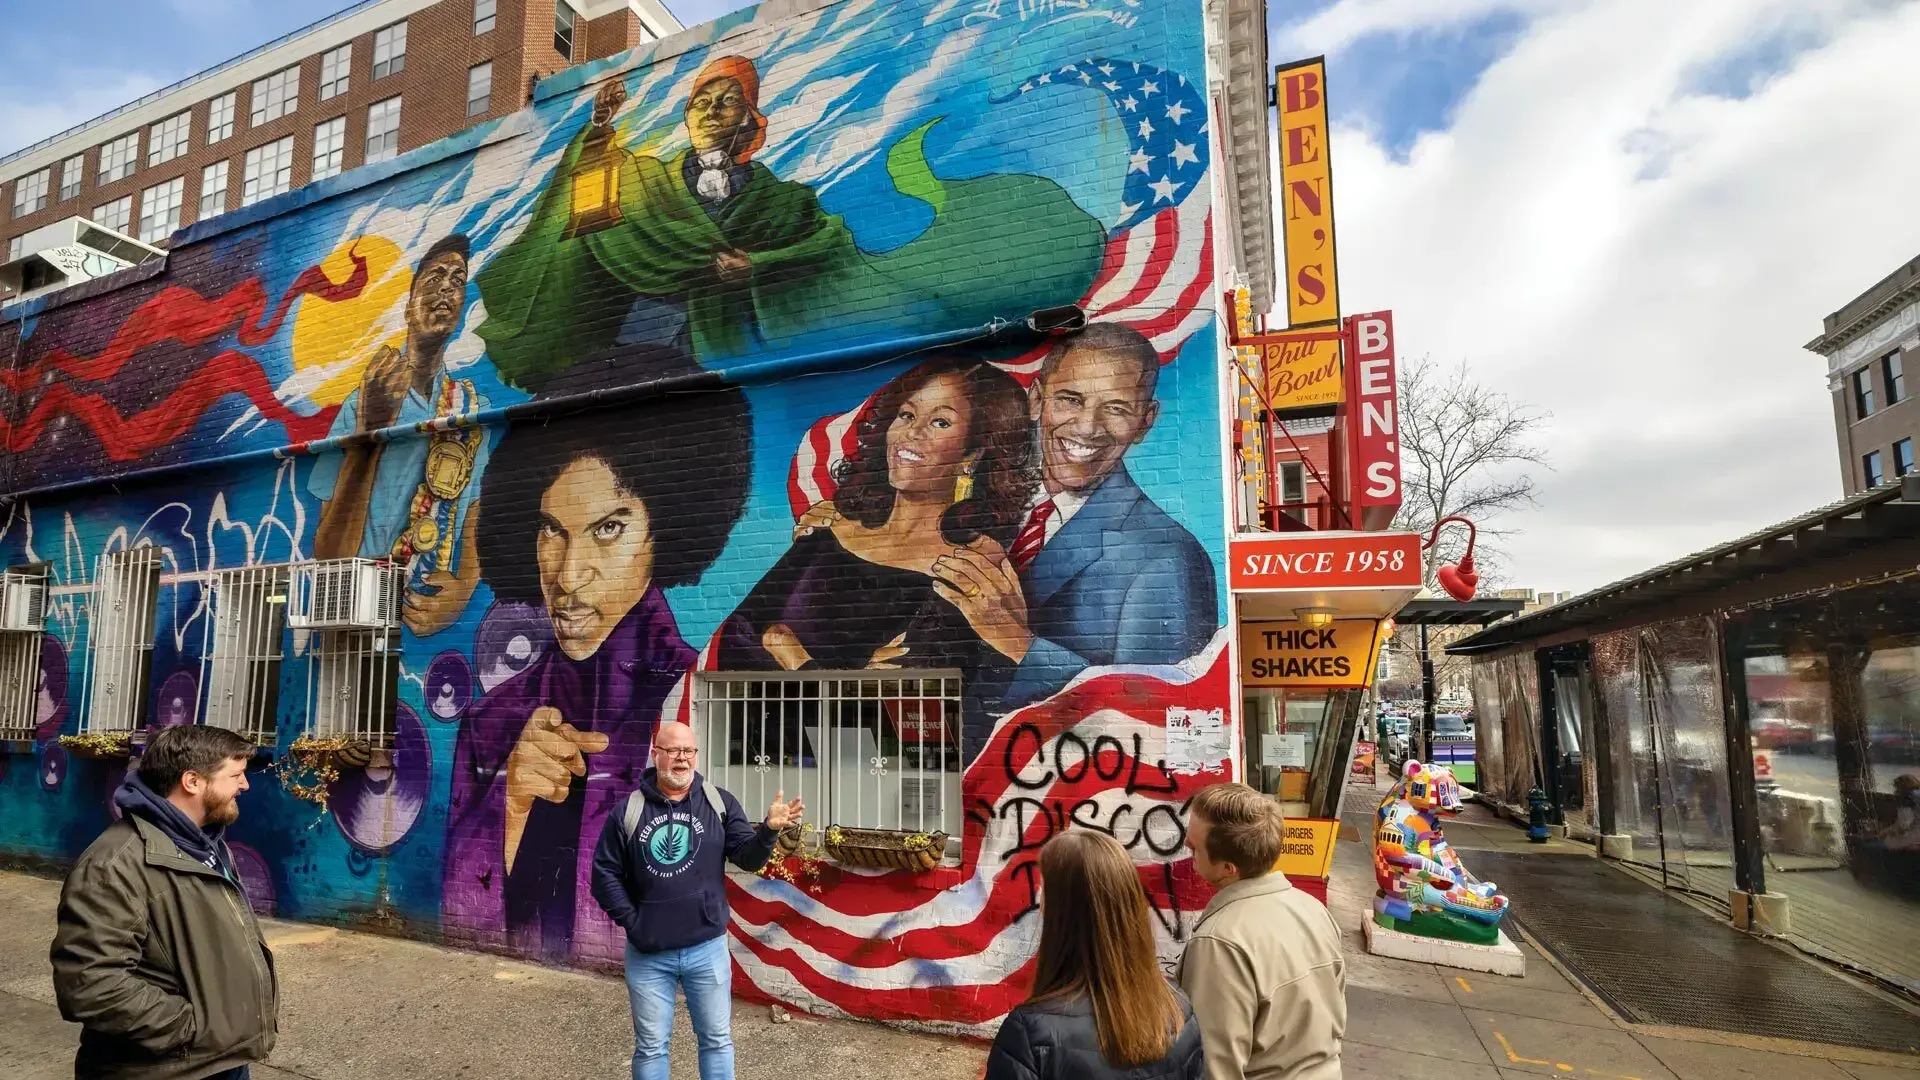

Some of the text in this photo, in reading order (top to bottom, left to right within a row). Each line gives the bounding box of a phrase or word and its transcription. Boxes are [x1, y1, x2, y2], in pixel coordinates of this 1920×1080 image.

[1281, 71, 1326, 307] BEN'S
[1265, 352, 1338, 400] Bowl
[1357, 319, 1396, 498] BEN'S
[1242, 549, 1405, 576] SINCE 1958
[1262, 628, 1337, 650] THICK
[1251, 656, 1351, 678] SHAKES
[1004, 722, 1179, 796] COOL
[639, 825, 653, 842] FEED
[651, 813, 668, 827] YOUR
[1282, 827, 1314, 839] URGERS
